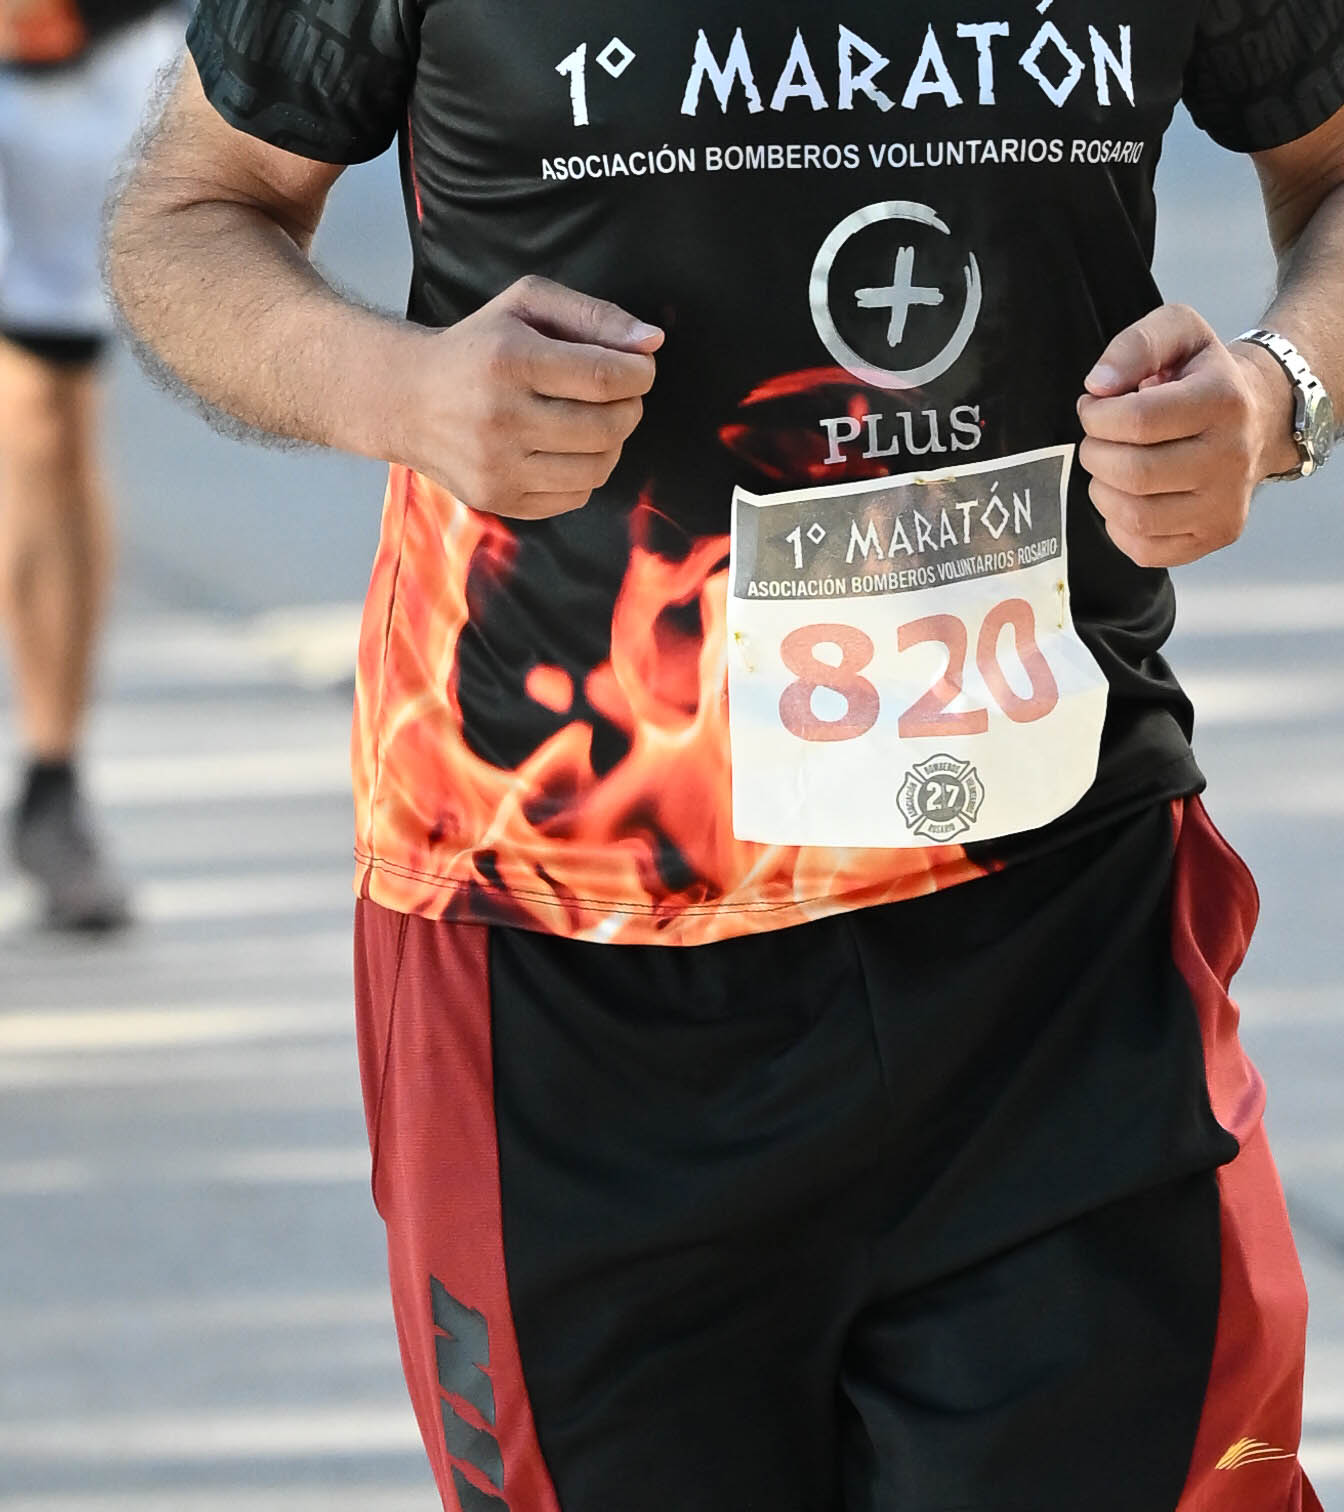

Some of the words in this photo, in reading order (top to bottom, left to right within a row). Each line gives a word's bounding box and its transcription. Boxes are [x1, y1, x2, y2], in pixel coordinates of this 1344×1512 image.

[541, 143, 696, 181] ASOCIACIÓN
[705, 144, 860, 172] BOMBEROS
[869, 138, 1064, 168] VOLUNTARIOS
[1070, 138, 1145, 166] ROSARIO
[846, 481, 1032, 563] MARATÓN
[747, 575, 844, 597] ASOCIACIÓN
[852, 566, 936, 594] BOMBEROS
[937, 550, 1015, 584] VOLUNTARIOS
[1017, 537, 1058, 566] ROSARIO
[779, 598, 1059, 742] 820
[926, 781, 959, 812] 27
